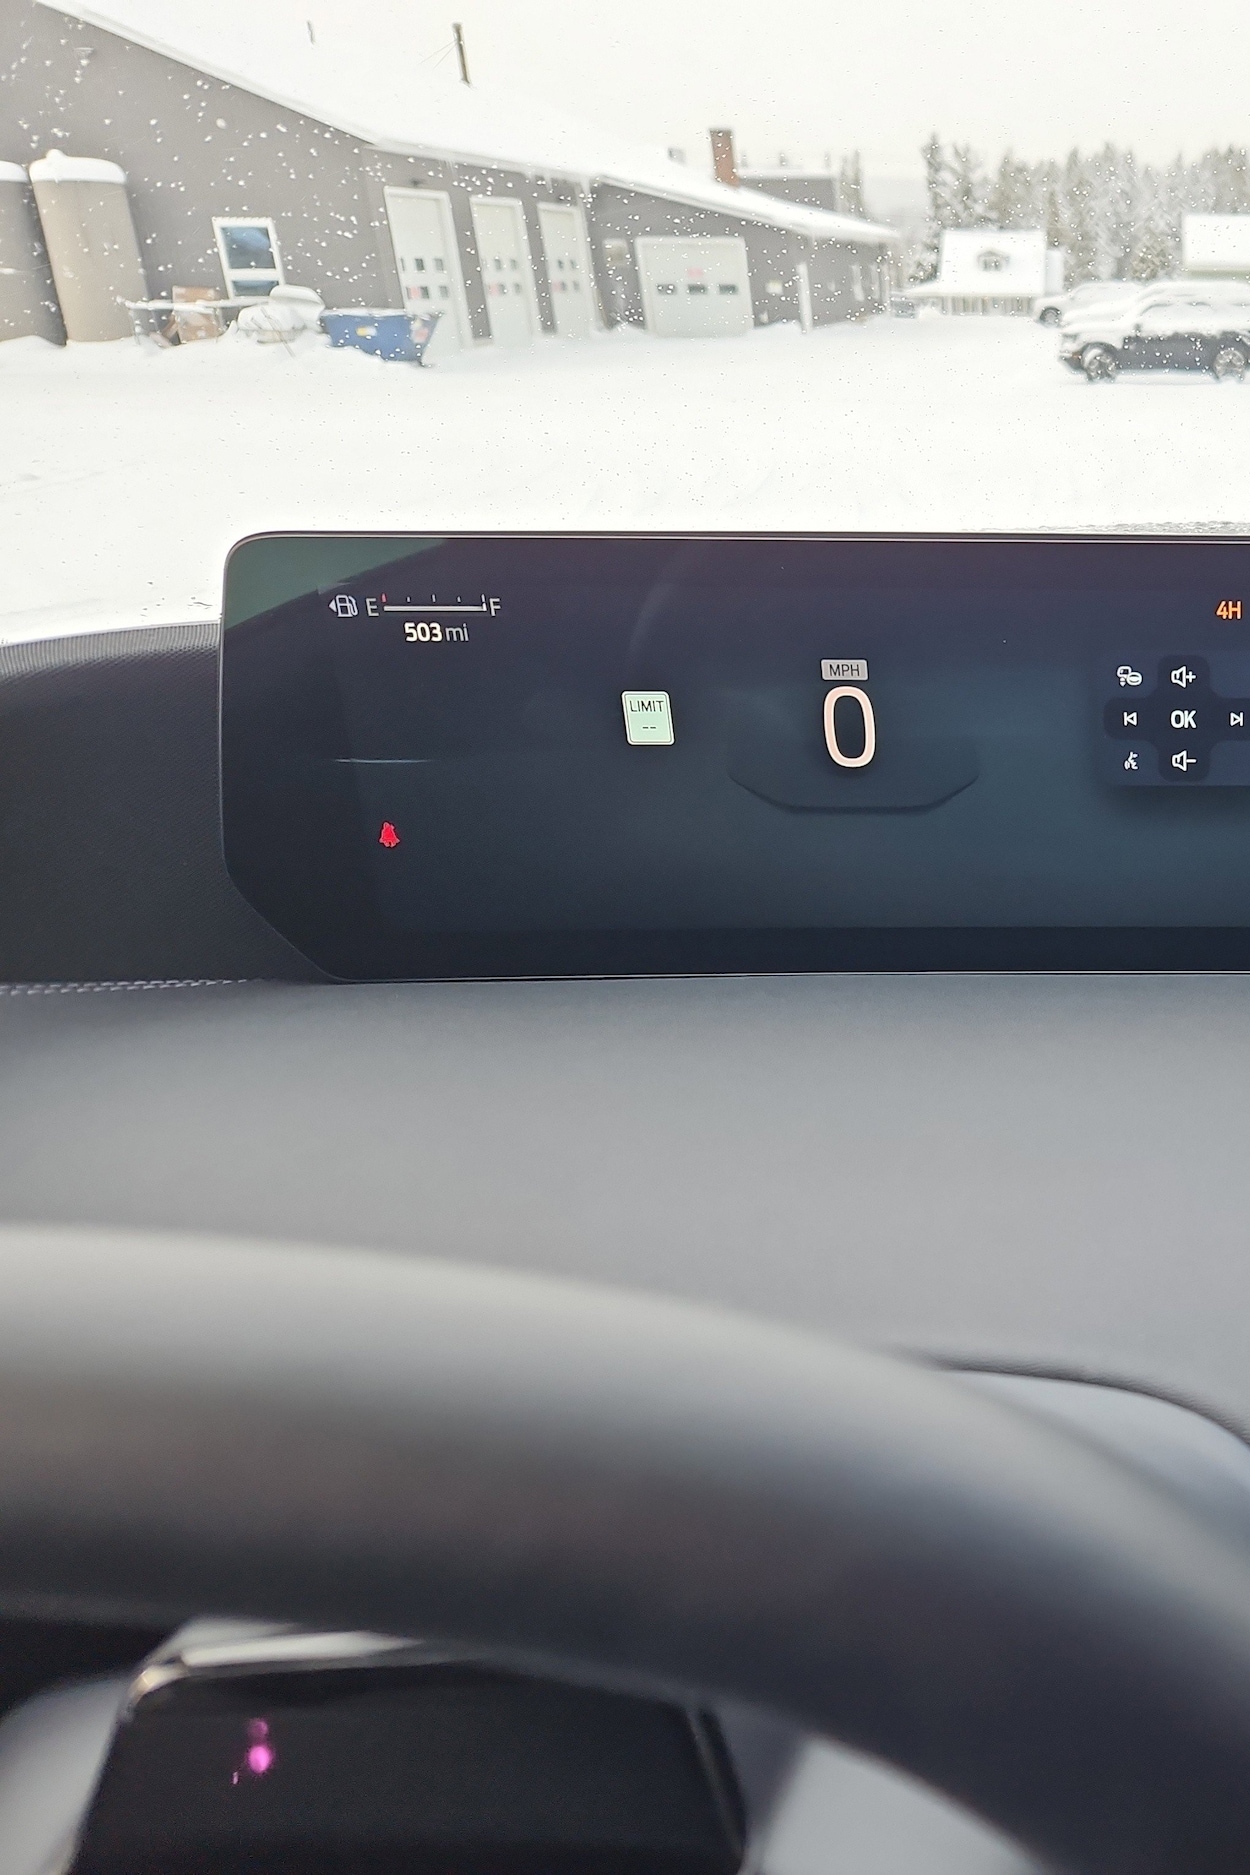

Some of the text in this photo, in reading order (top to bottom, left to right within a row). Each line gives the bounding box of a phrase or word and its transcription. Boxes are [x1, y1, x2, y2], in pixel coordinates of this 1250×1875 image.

[365, 597, 379, 617] E
[489, 597, 501, 617] F
[1215, 600, 1242, 620] 4H
[404, 622, 469, 642] 503 mi
[829, 663, 860, 677] MPH
[629, 700, 664, 712] LIMIT
[823, 685, 876, 768] 0
[1170, 709, 1197, 729] OK
